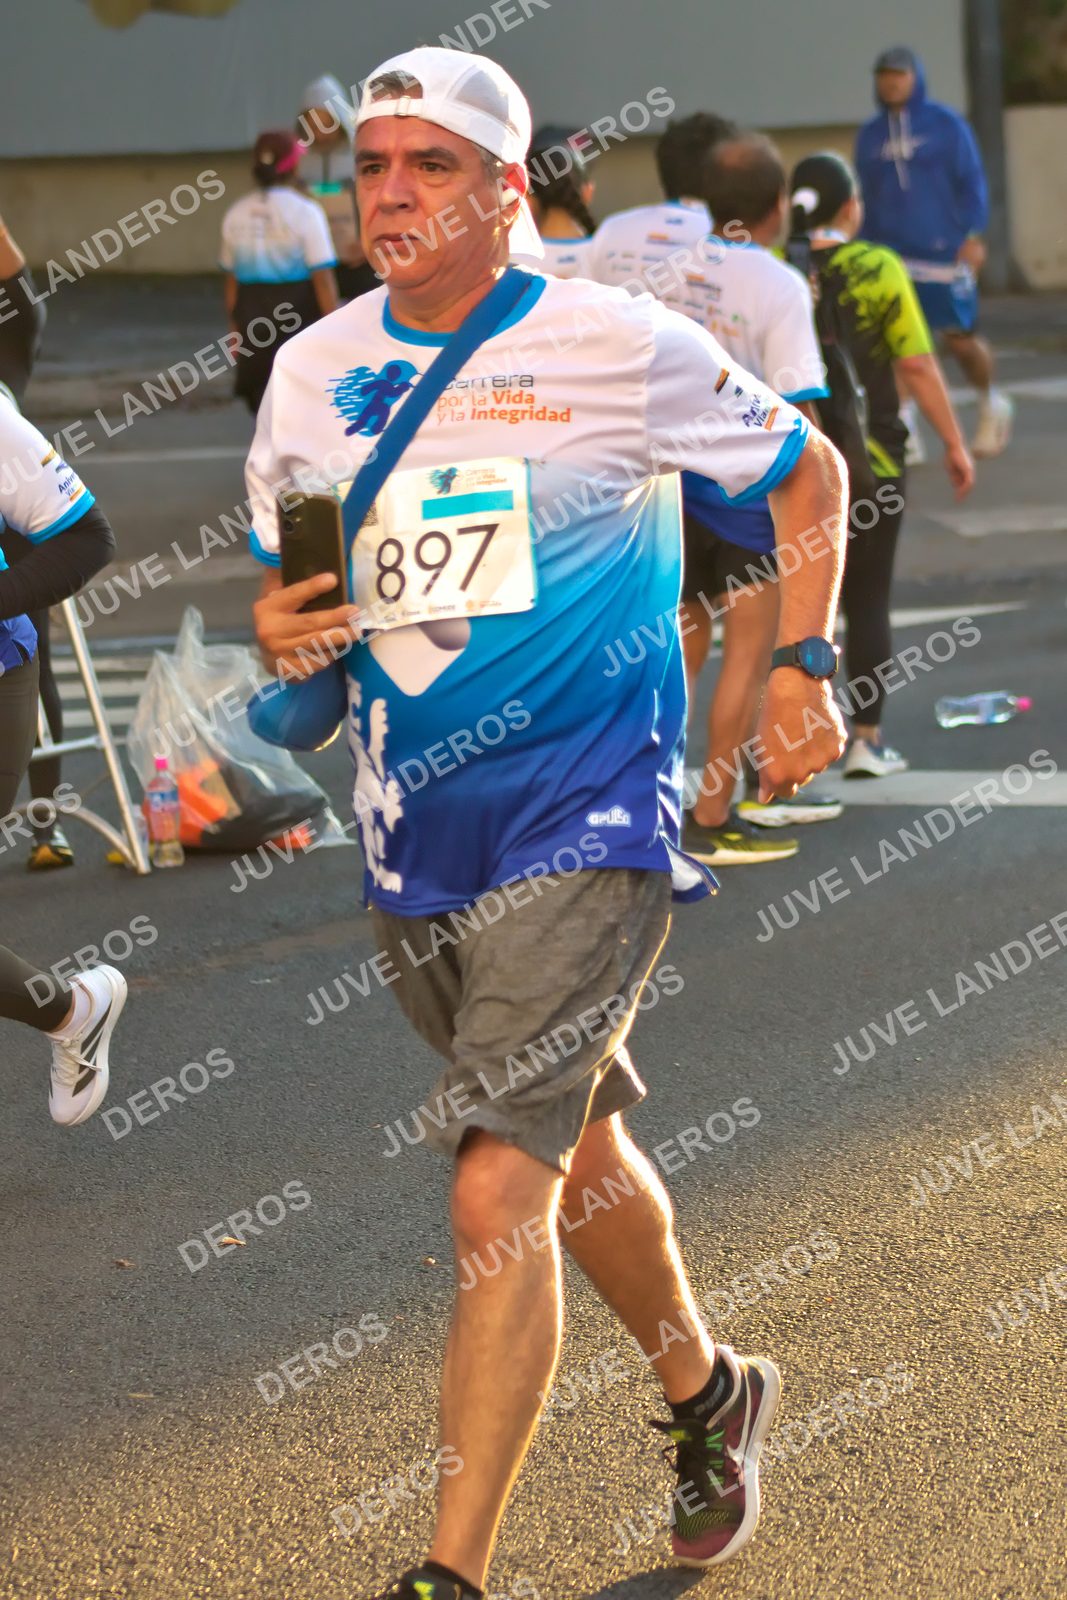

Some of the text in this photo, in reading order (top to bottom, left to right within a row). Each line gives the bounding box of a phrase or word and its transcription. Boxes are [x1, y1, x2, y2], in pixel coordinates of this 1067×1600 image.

[437, 390, 535, 412] por la Vida
[436, 405, 571, 426] y la Integridad
[377, 523, 500, 604] 897
